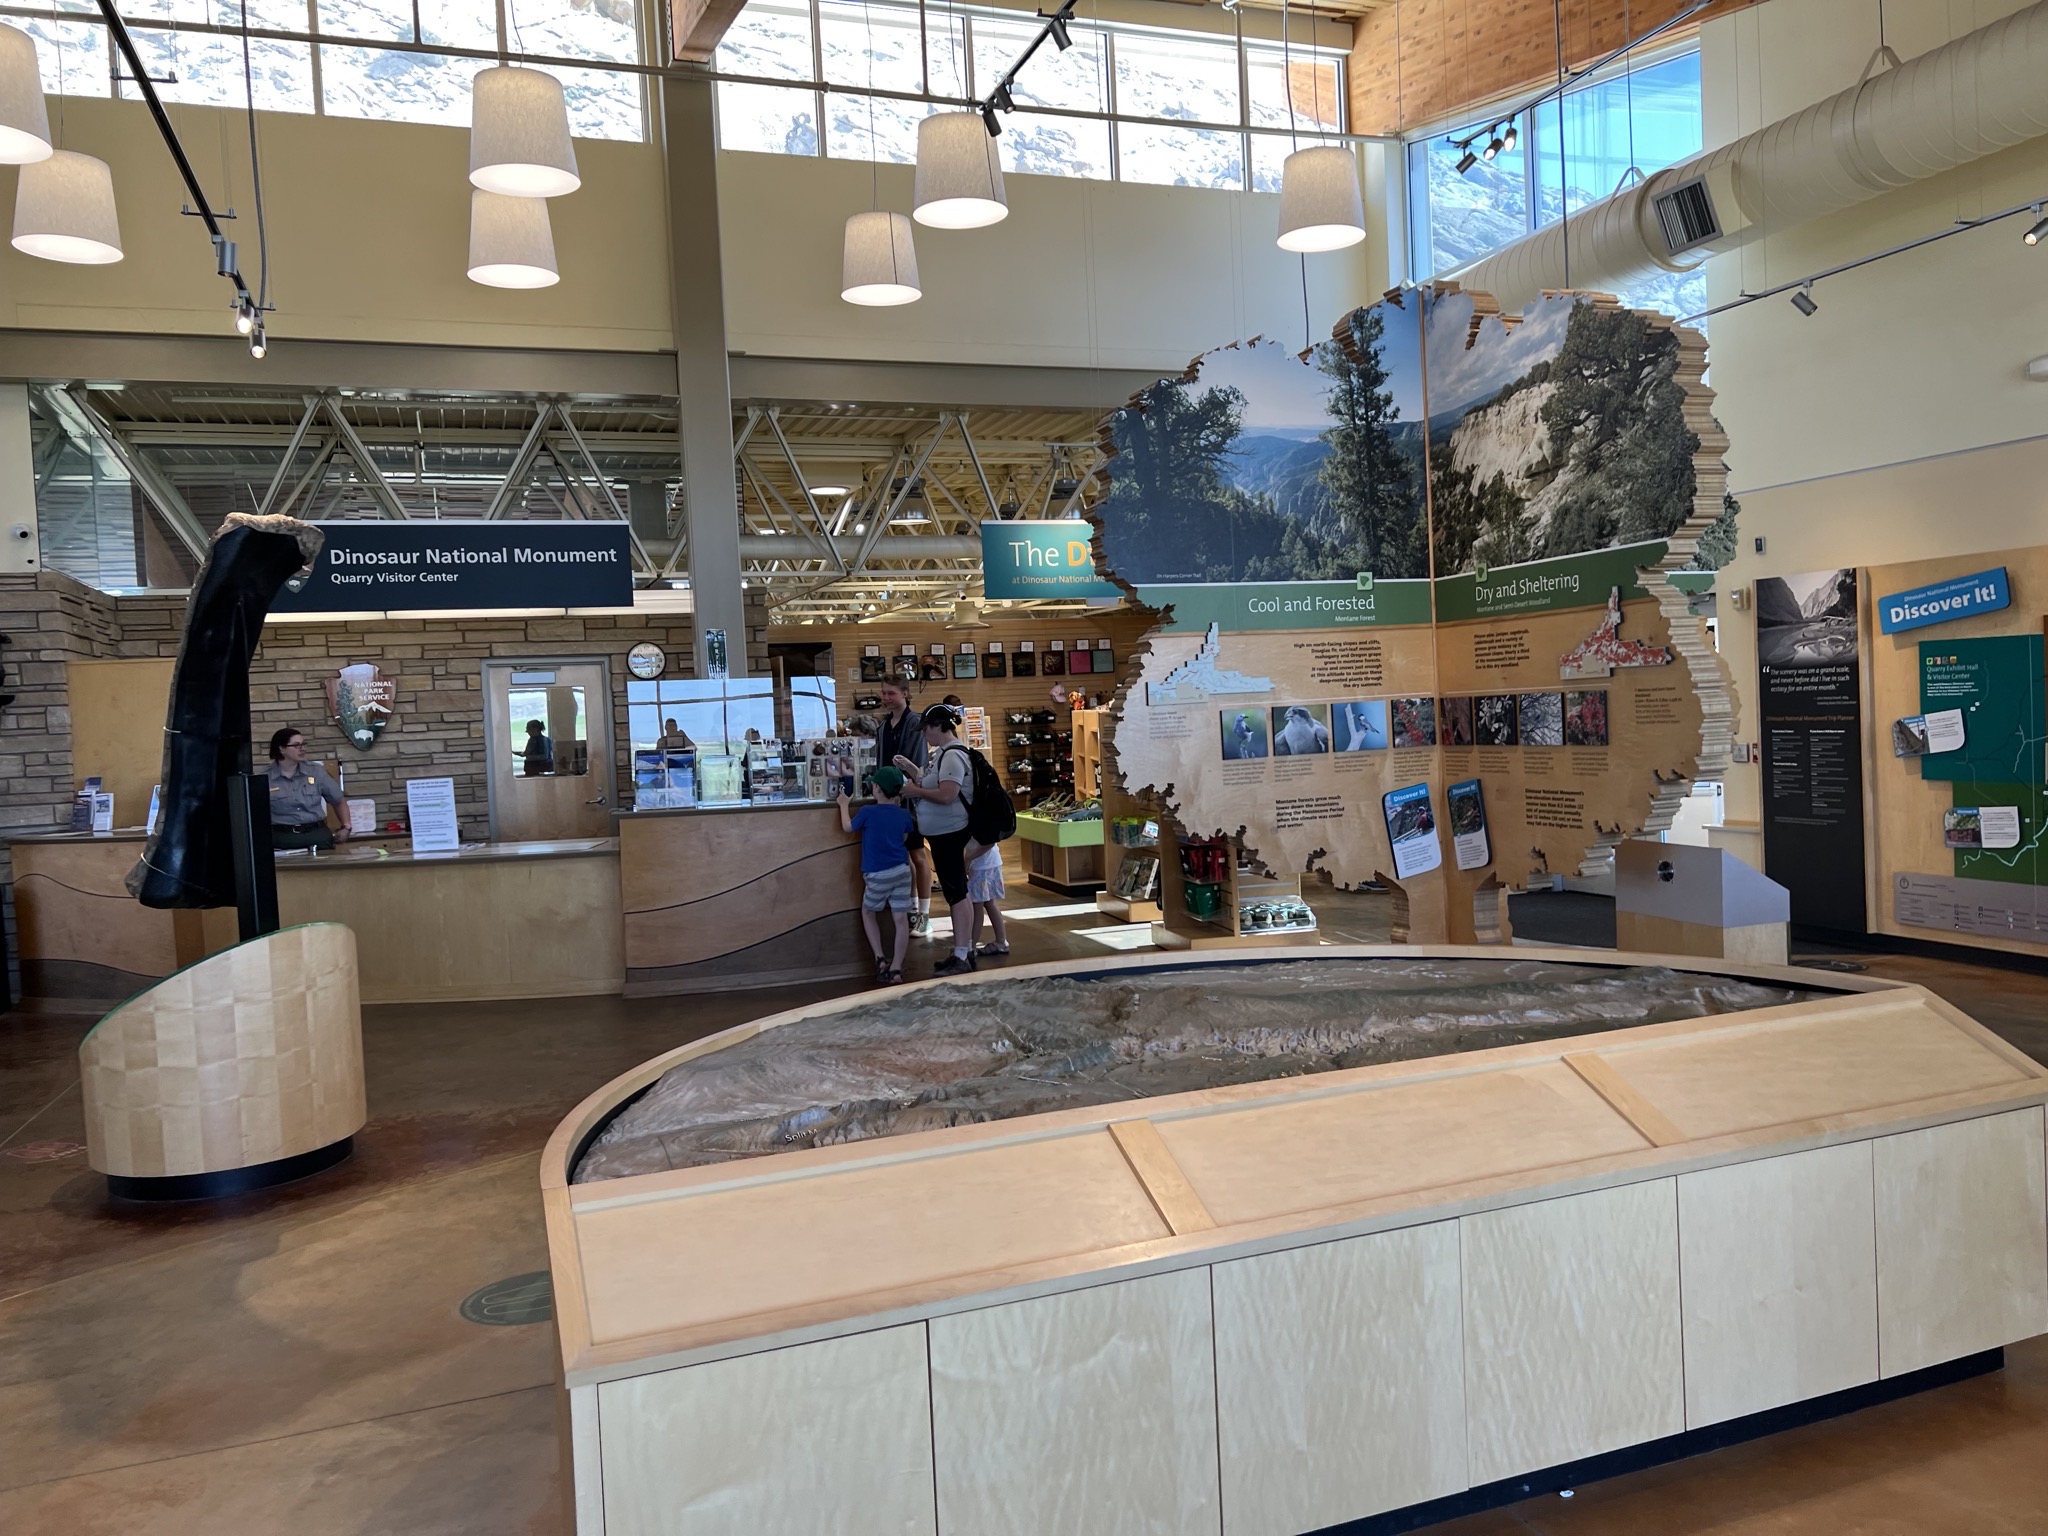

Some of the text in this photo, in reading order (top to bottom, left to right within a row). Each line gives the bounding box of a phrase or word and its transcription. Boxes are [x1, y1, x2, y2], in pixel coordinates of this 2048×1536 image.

[330, 547, 617, 565] Dinosaur National Monument
[1009, 540, 1059, 566] The
[331, 572, 459, 585] Quarry Visitor Center
[1012, 576, 1020, 584] at
[1022, 576, 1056, 584] Dinosaur
[1058, 575, 1091, 583] National
[1476, 574, 1579, 604] Dry and Sheltering
[1904, 579, 1978, 602] Dinosaur National Monument
[1248, 595, 1375, 612] Cool and Forested
[1504, 601, 1528, 609] Semi-Desert
[1890, 584, 1996, 623] Discover It!
[1795, 676, 1809, 684] before
[1787, 685, 1795, 693] for
[1393, 792, 1418, 802] Discover
[1452, 787, 1470, 795] Discover
